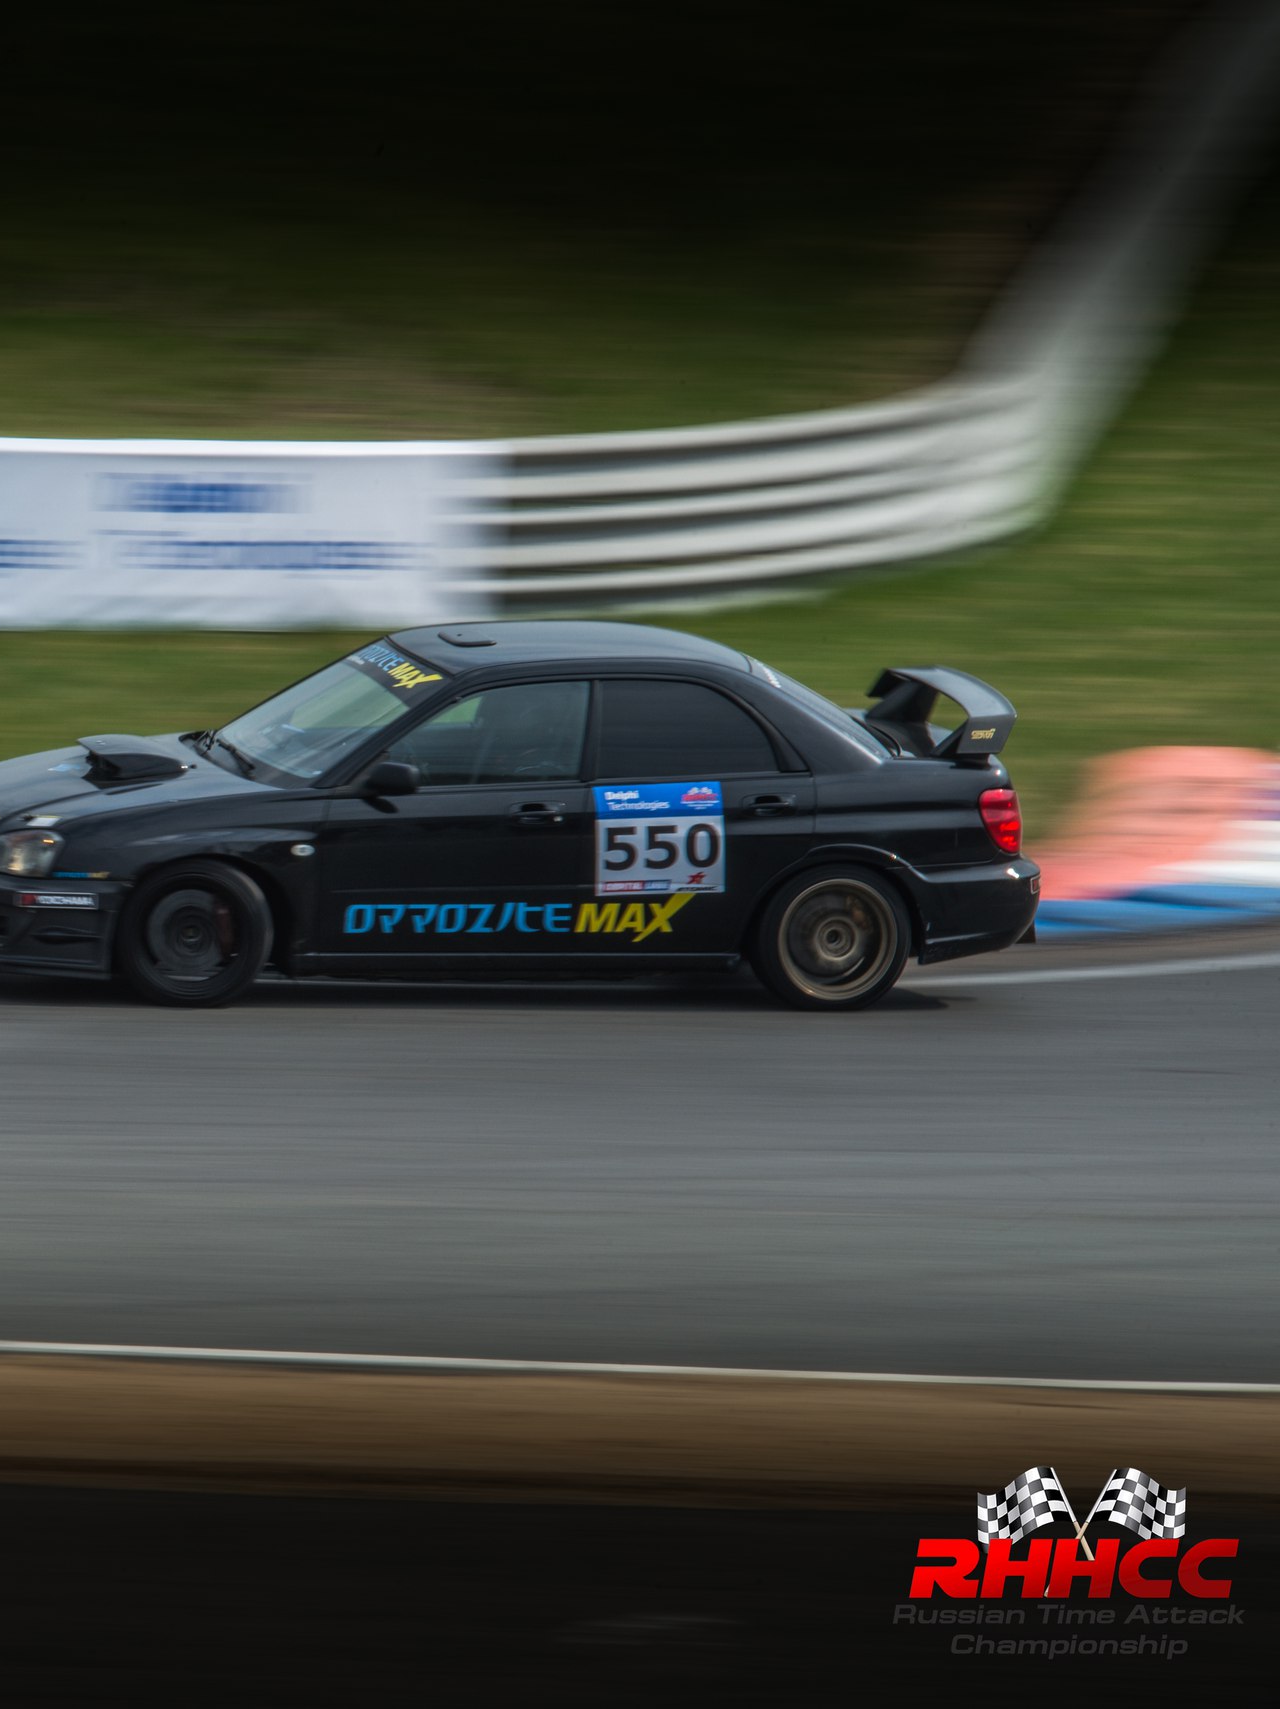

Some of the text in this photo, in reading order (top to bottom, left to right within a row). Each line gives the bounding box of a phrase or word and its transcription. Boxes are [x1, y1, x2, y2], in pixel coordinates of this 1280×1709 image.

[387, 662, 443, 688] MAX
[603, 823, 720, 871] 550
[574, 893, 696, 942] MAX
